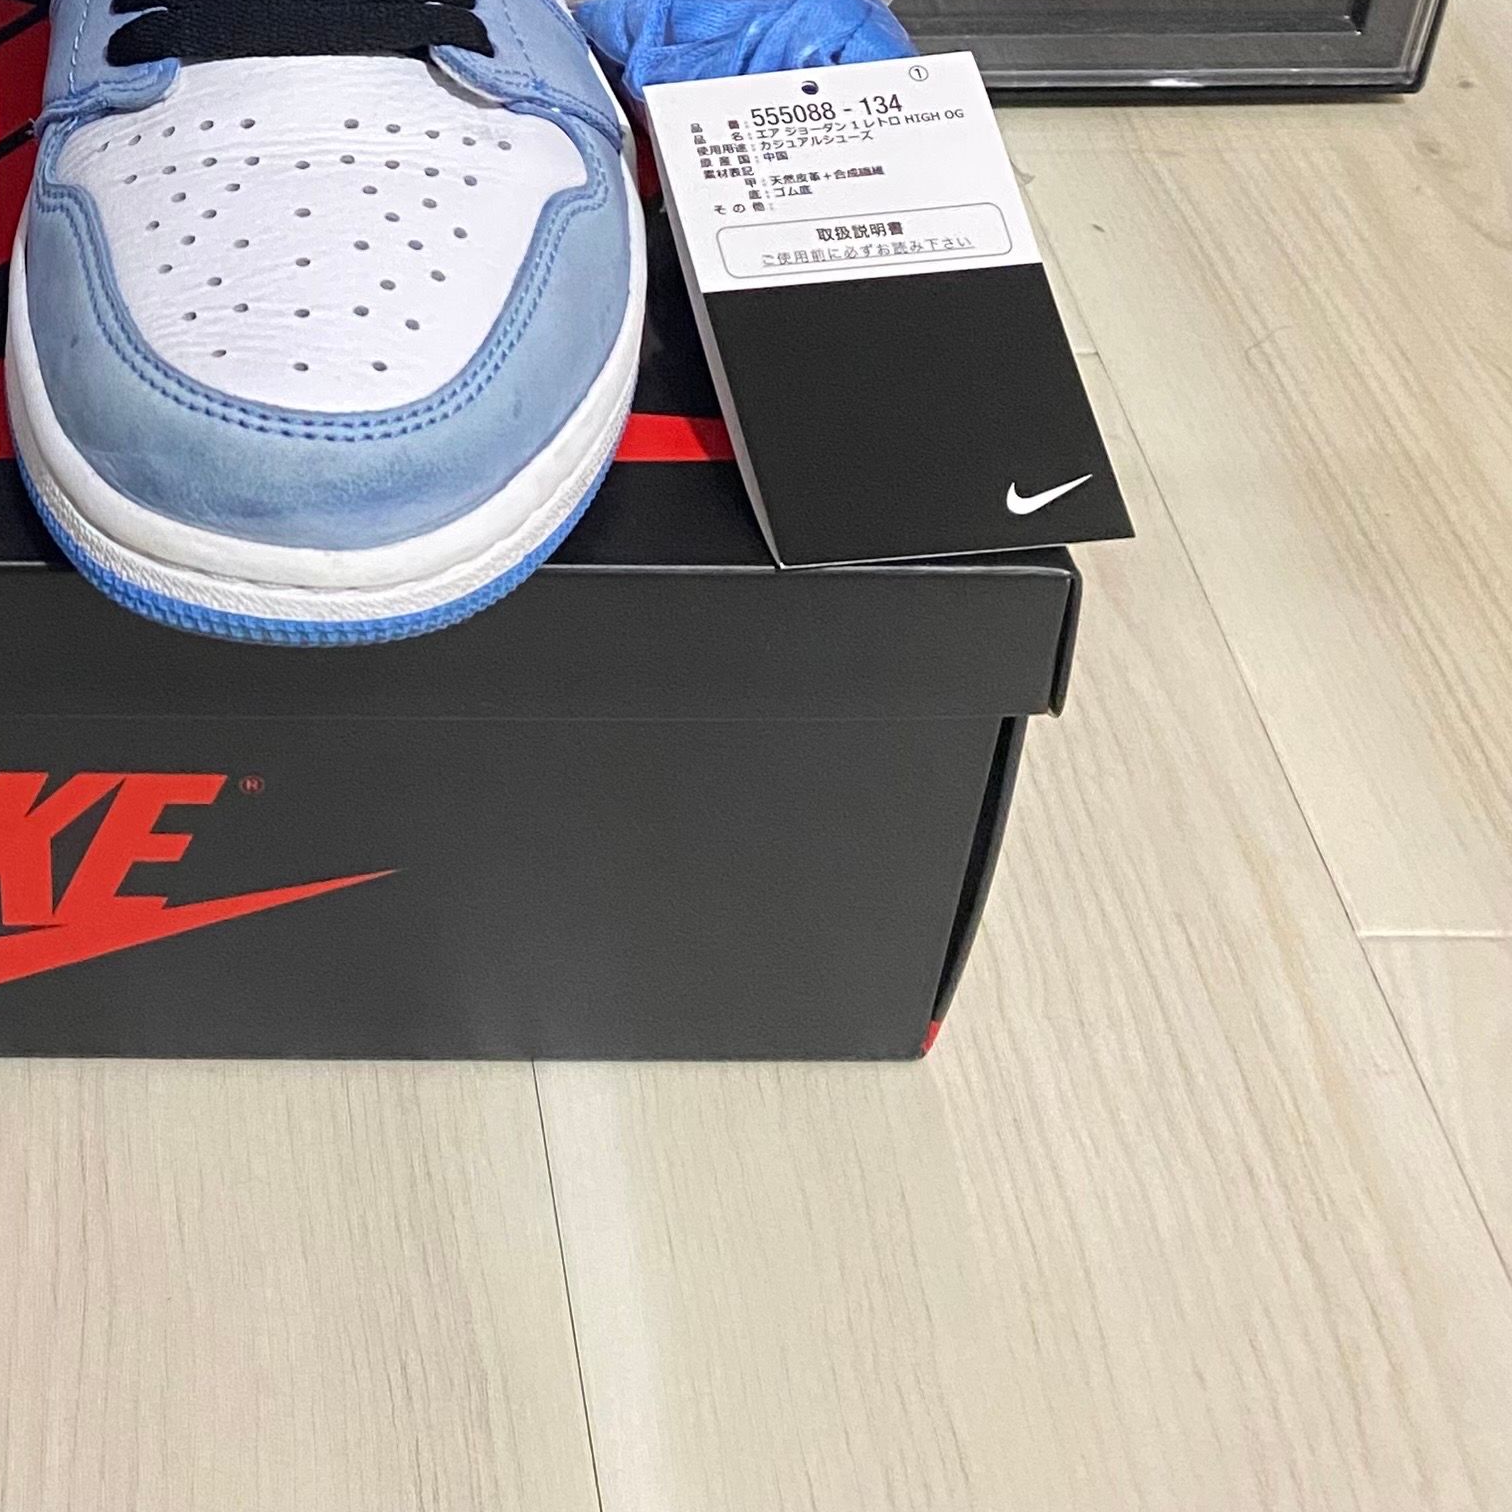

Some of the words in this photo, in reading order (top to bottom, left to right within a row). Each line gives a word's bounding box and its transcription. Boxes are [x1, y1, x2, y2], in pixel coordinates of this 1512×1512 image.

[750, 101, 837, 127] 555088
[859, 93, 903, 117] 134
[904, 111, 941, 124] HIGH
[943, 108, 965, 120] OG
[816, 221, 905, 242] 取扱説明書
